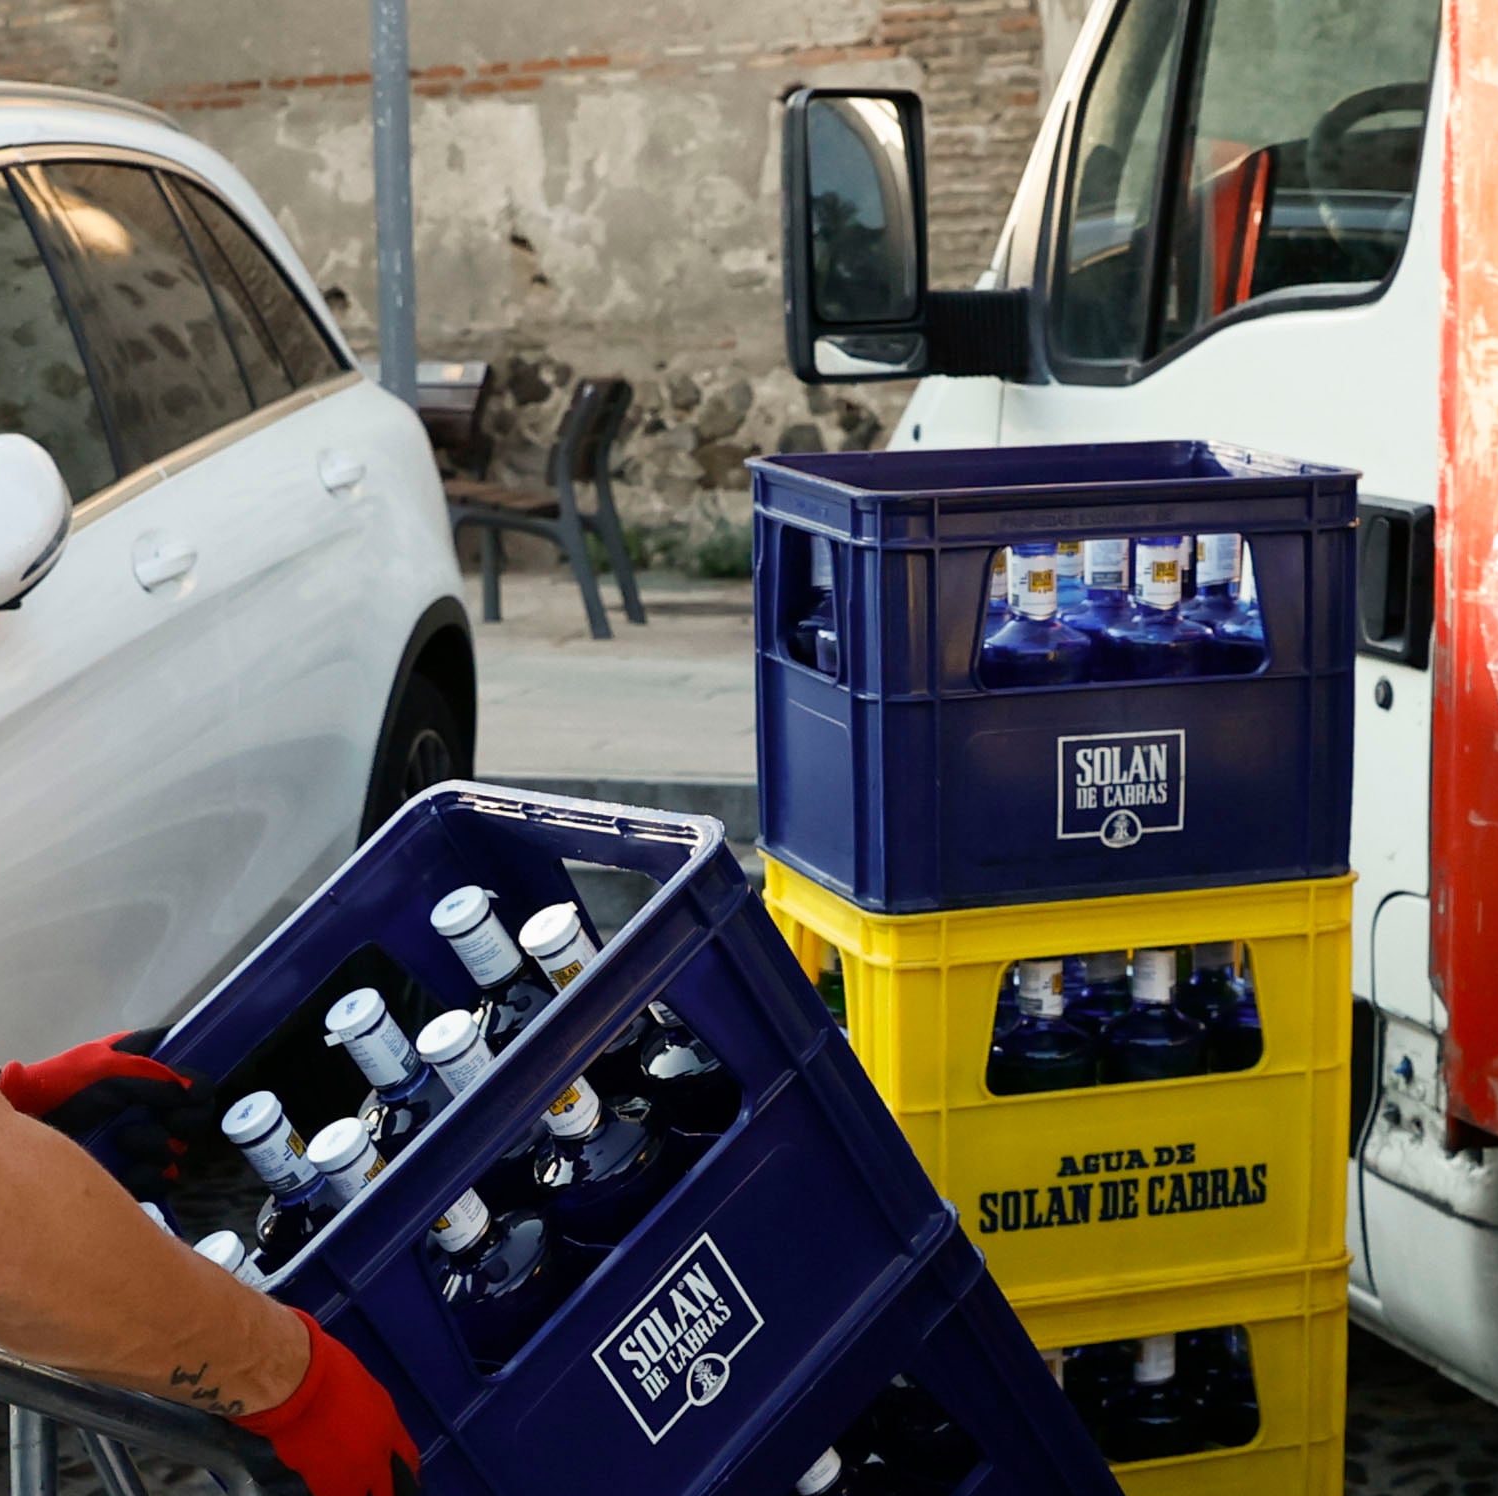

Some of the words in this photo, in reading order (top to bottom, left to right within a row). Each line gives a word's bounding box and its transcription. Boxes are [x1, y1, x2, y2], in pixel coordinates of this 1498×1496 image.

[1075, 743, 1168, 787] SOLAN
[1076, 786, 1098, 810] DE
[1103, 782, 1169, 808] CABRAS
[1057, 1149, 1149, 1177] AGUA
[1153, 1143, 1195, 1168] DE
[980, 1182, 1093, 1234] SOLAN
[1098, 1178, 1139, 1222] DE
[1147, 1163, 1268, 1217] CABRAS
[618, 1261, 719, 1380] SOLAN
[640, 1365, 671, 1402] DE
[665, 1296, 732, 1375] CABRAS
